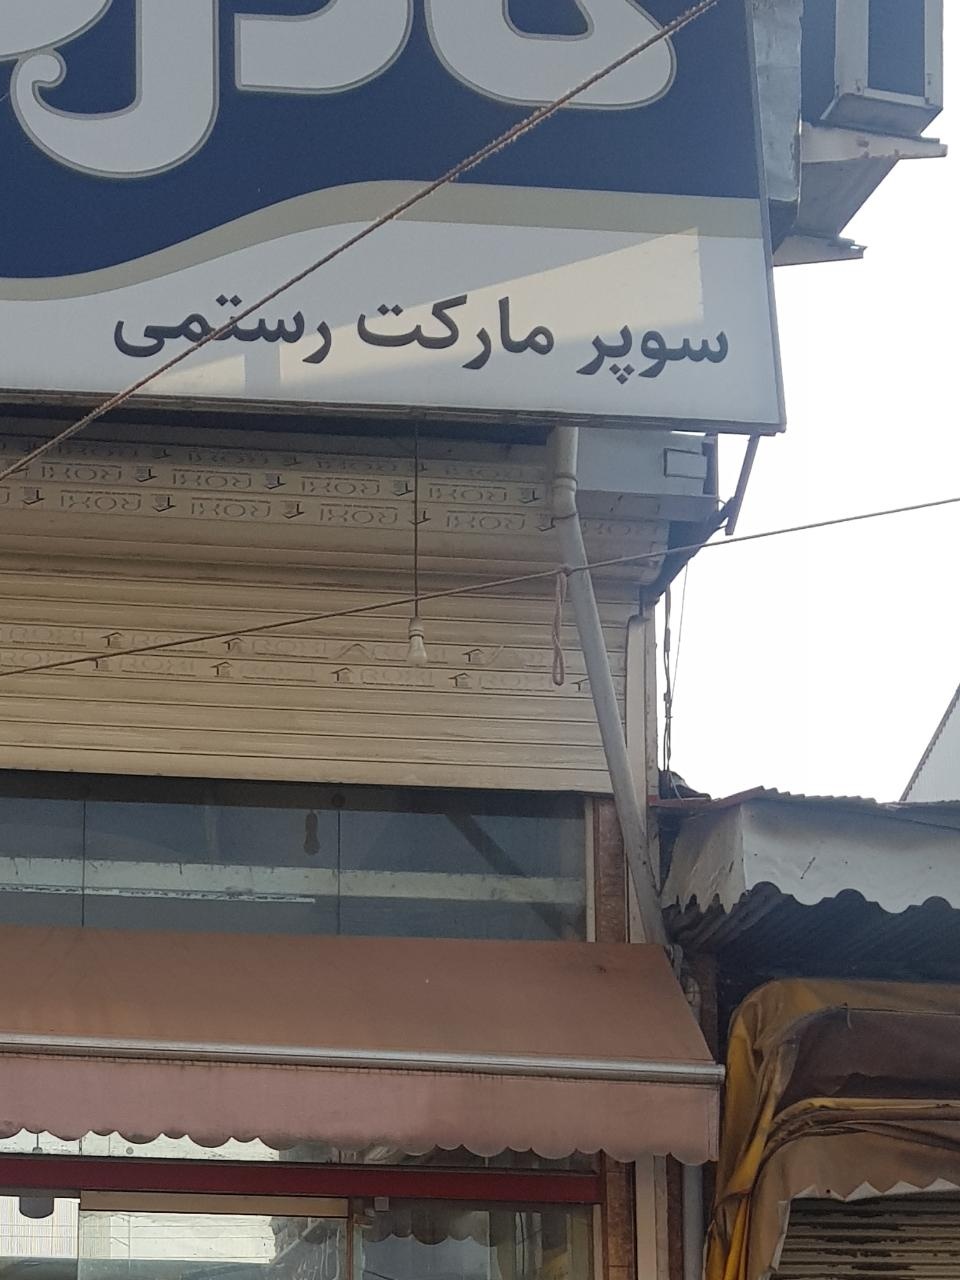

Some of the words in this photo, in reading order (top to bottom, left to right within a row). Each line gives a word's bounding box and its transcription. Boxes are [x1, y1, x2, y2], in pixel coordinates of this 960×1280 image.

[112, 294, 331, 364] رستمی
[356, 294, 556, 370] مارکت
[575, 321, 730, 385] سوپر
